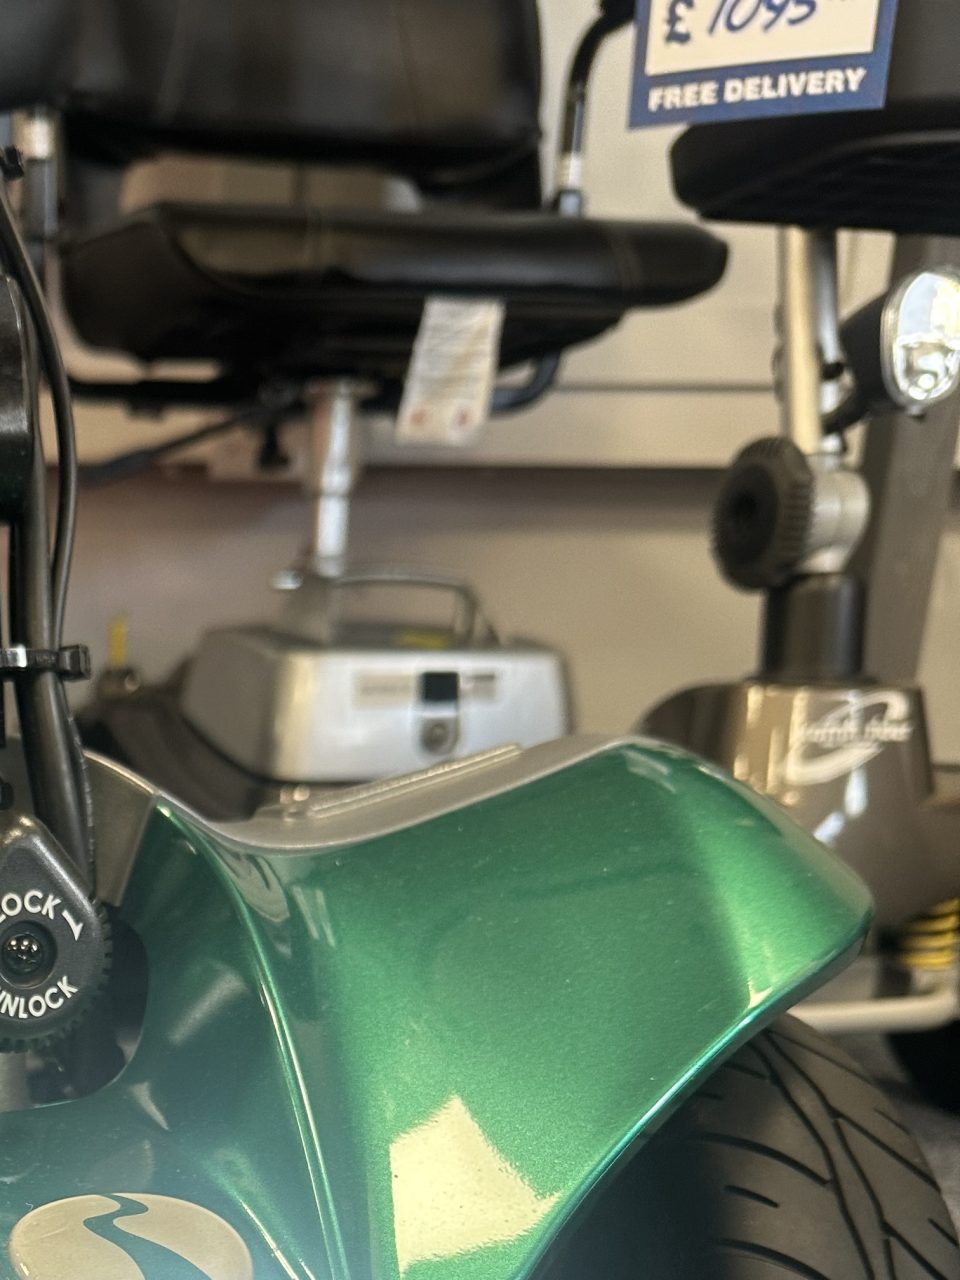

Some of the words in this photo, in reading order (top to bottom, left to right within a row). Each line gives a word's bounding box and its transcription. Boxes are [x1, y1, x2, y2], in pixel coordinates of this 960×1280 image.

[664, 0, 693, 44] £
[647, 79, 719, 112] FREE
[723, 66, 867, 104] DELIVERY
